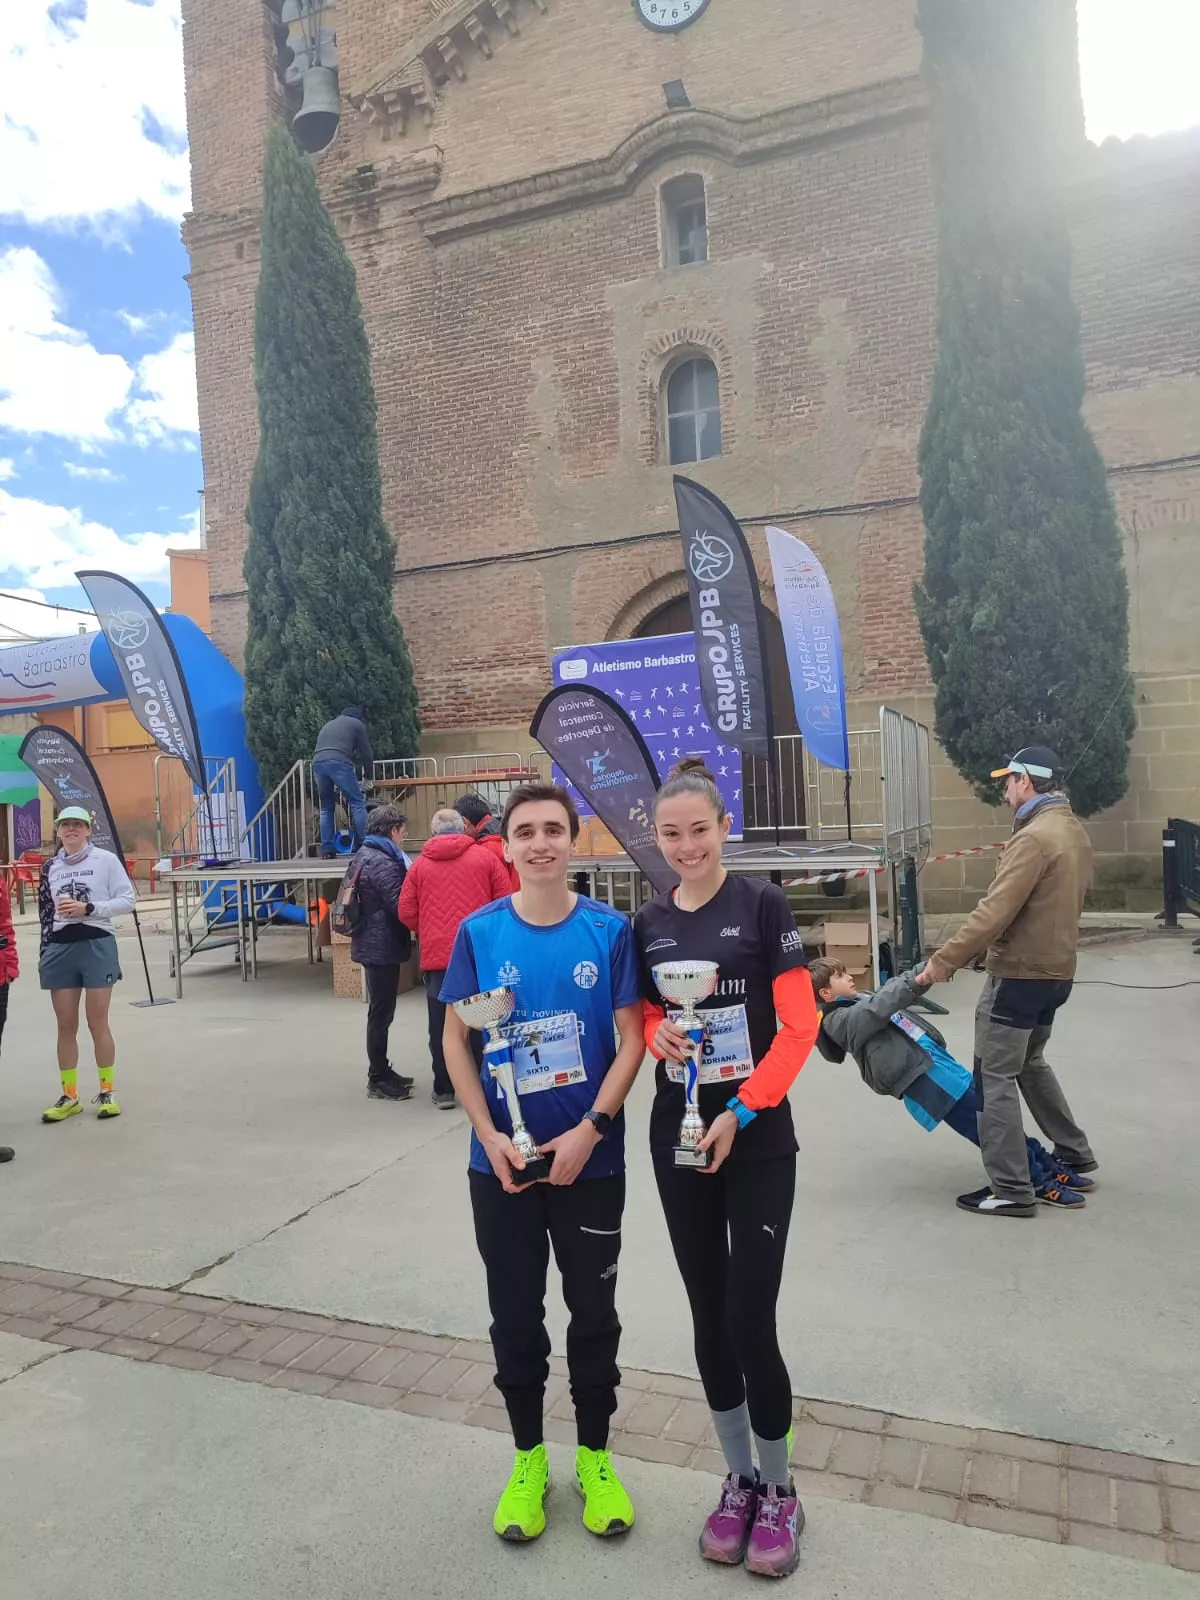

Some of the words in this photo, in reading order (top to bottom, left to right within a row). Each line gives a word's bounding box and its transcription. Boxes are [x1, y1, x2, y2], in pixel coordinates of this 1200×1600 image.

[650, 3, 657, 13] 8
[660, 8, 667, 19] 7
[671, 8, 678, 18] 6
[683, 1, 690, 11] 5
[729, 623, 746, 677] SERVICES
[24, 653, 86, 677] Barbastro
[592, 659, 641, 673] Atletismo
[644, 653, 696, 668] Barbastro
[157, 679, 177, 723] SERVICES
[739, 679, 752, 730] FACILITY
[702, 1039, 715, 1056] 6
[529, 1048, 541, 1065] 1
[702, 1054, 737, 1065] ADRIANA
[526, 1066, 550, 1076] SIXTO
